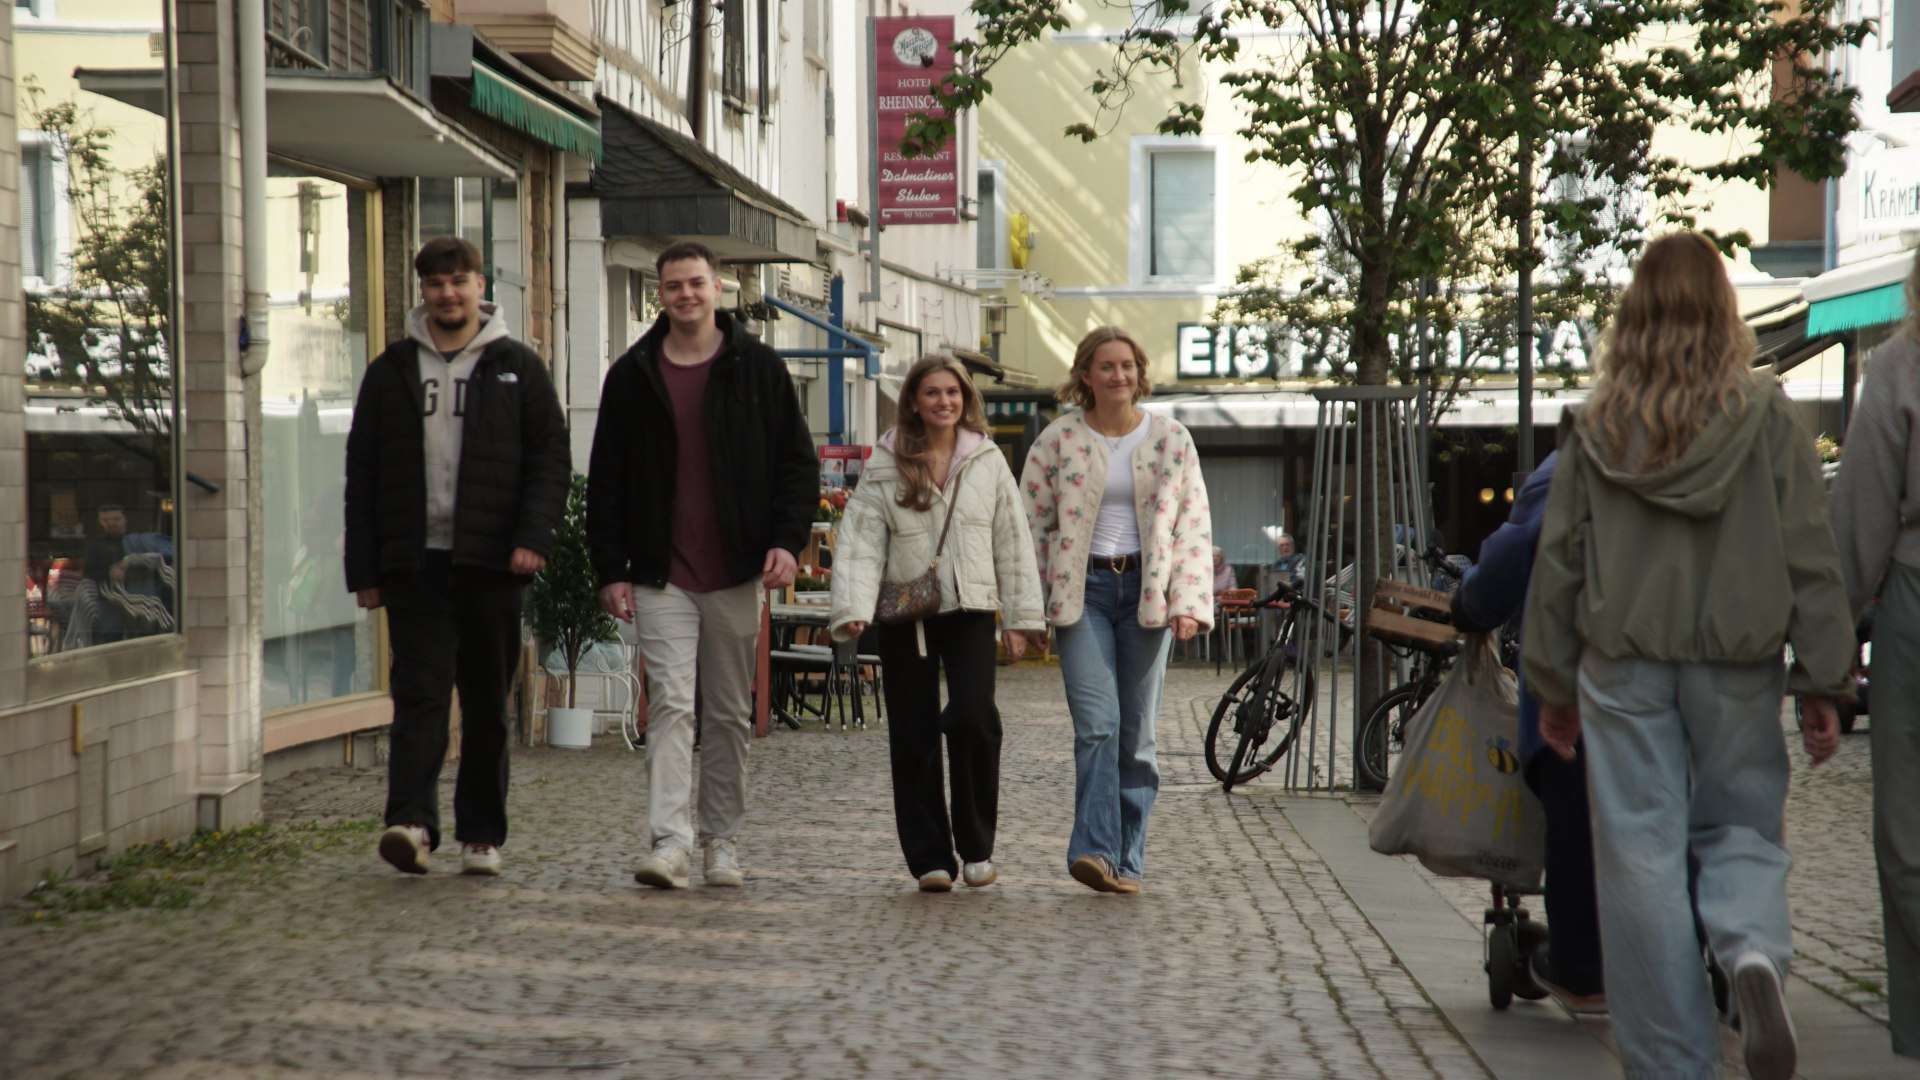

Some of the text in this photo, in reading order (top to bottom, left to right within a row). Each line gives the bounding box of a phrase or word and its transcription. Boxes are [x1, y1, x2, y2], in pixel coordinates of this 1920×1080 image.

[881, 168, 954, 181] Dalmatiner
[896, 188, 940, 201] Stuben
[1403, 757, 1521, 841] HAPPY!
